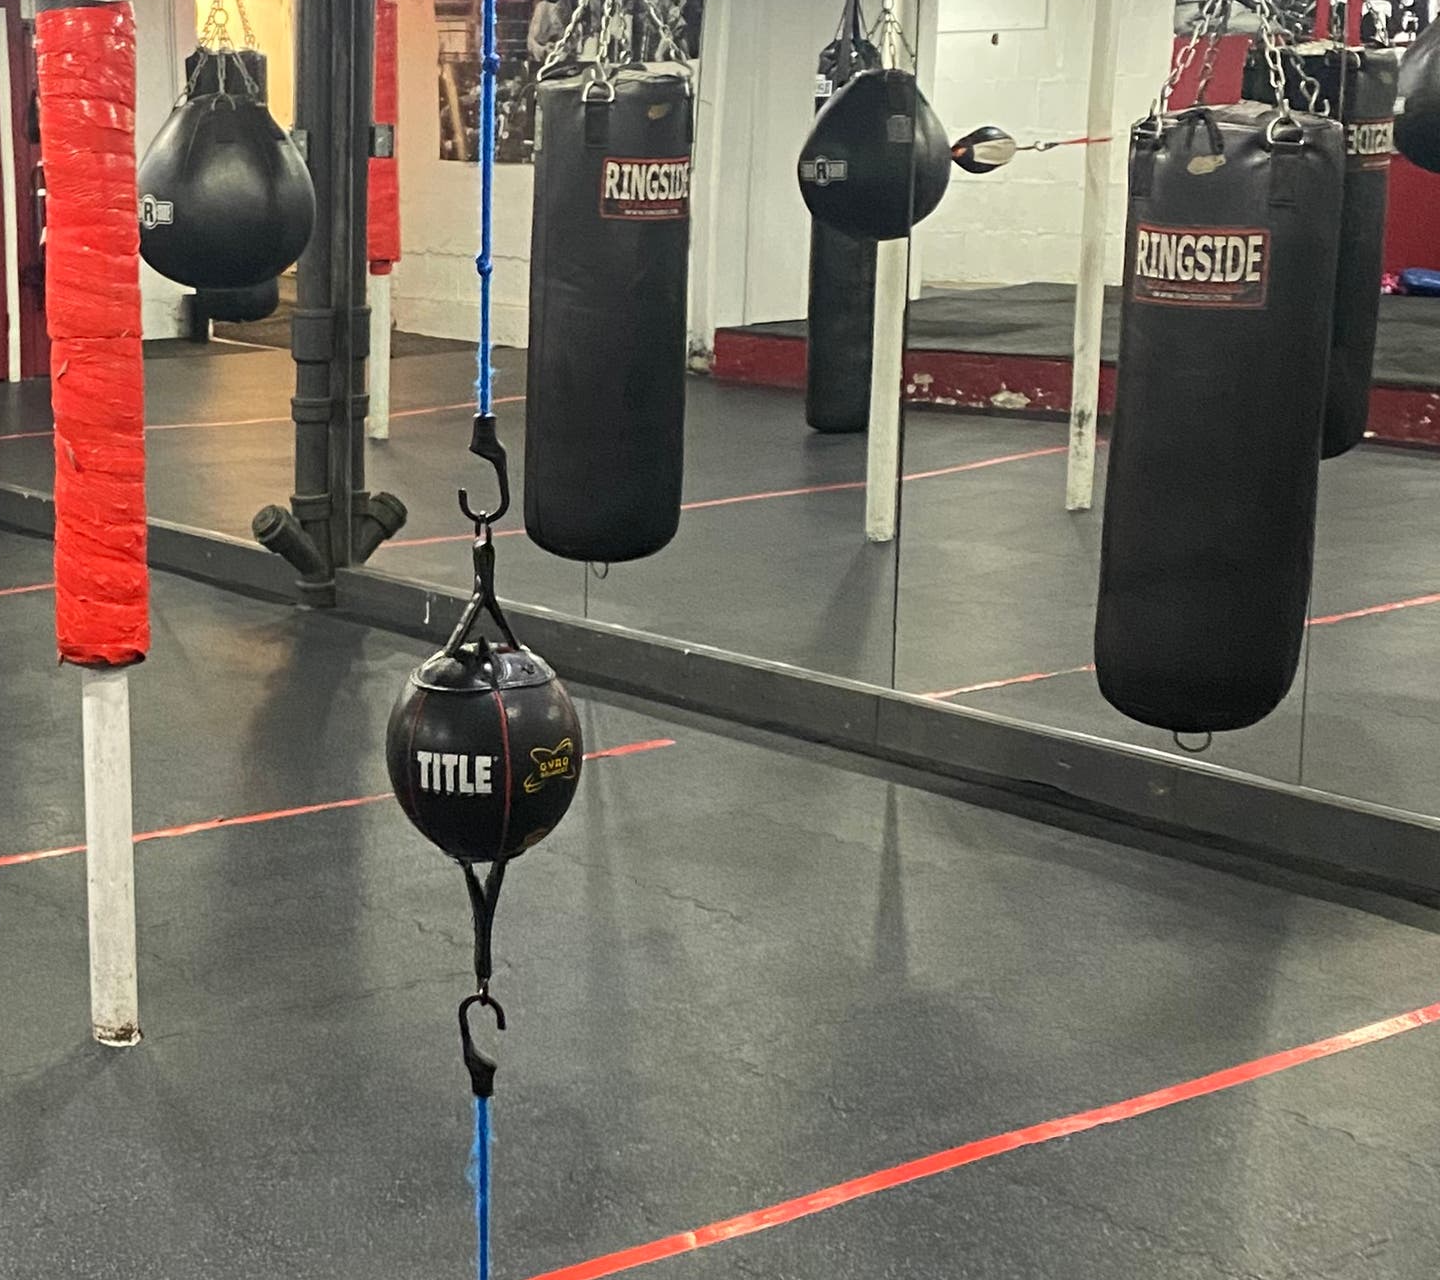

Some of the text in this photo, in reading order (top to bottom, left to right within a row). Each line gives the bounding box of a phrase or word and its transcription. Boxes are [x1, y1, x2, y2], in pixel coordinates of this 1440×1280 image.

[605, 161, 689, 201] RINGSIDE
[1136, 230, 1263, 282] RINGSIDE
[416, 750, 493, 794] TITLE
